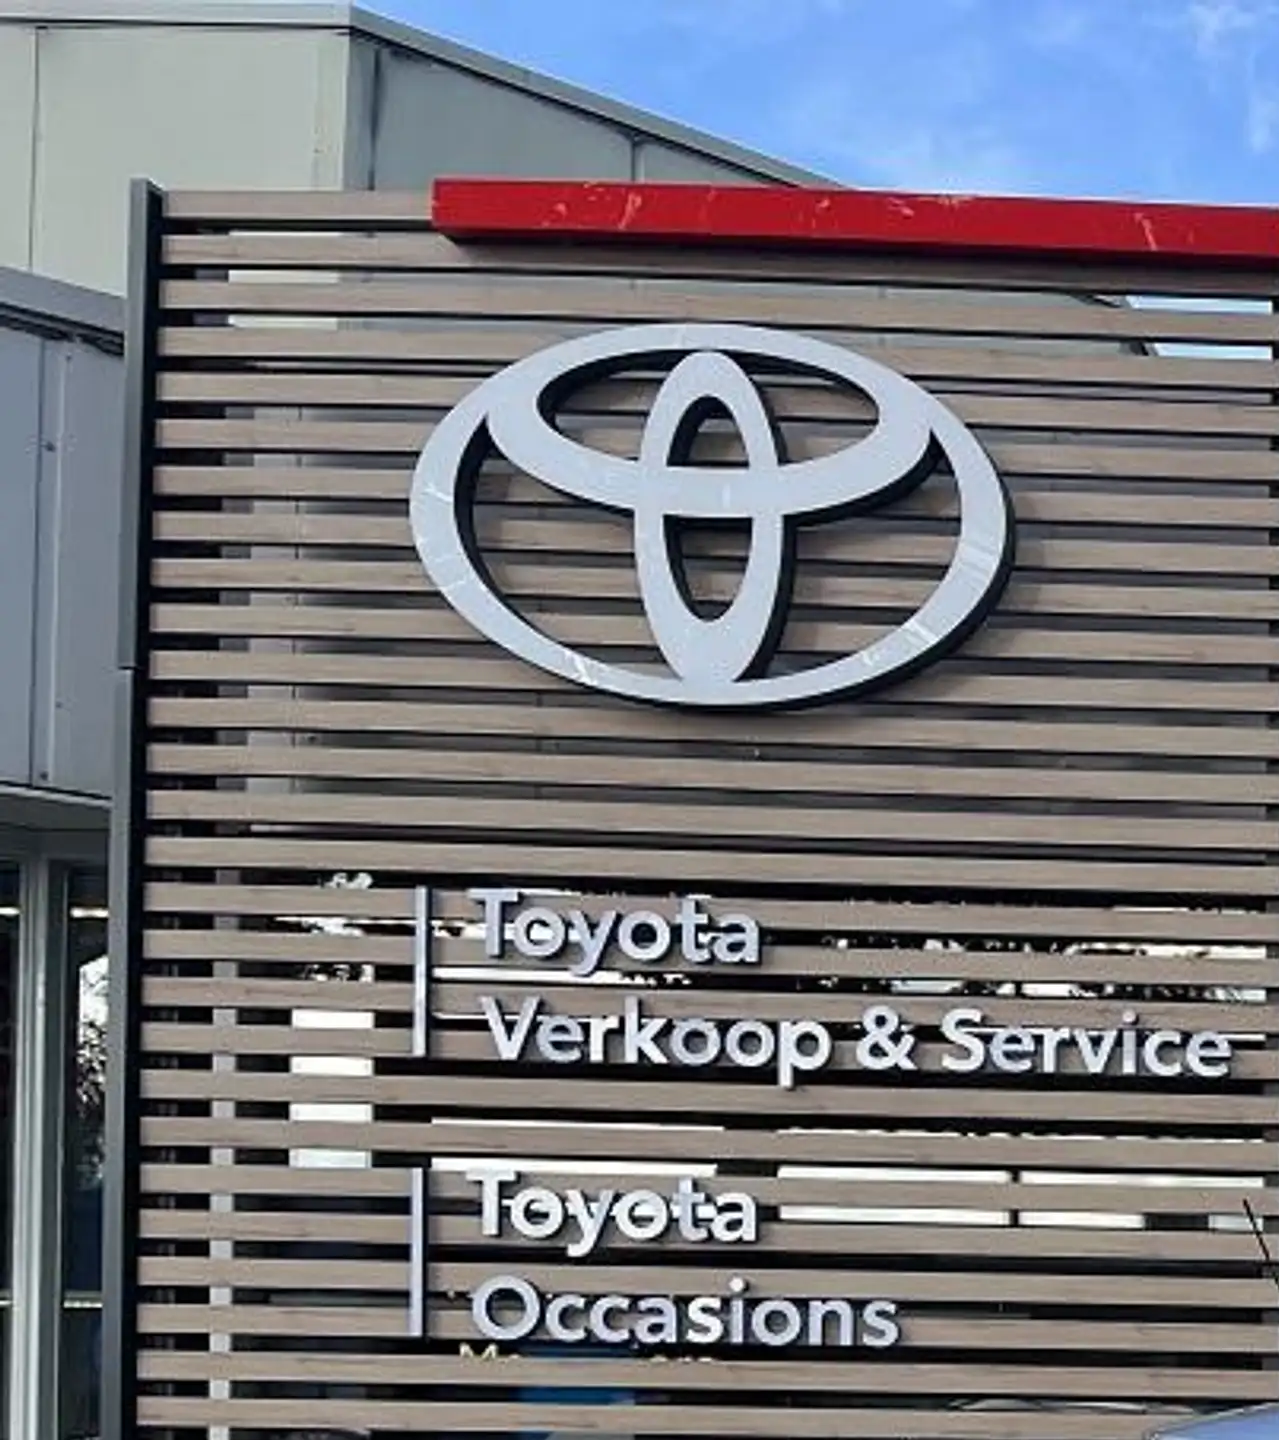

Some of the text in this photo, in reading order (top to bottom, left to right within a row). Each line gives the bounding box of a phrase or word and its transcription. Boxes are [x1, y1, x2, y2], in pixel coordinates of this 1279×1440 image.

[470, 889, 760, 975] Toyota
[481, 997, 1232, 1088] Verkoop & Service
[468, 1170, 760, 1254] Toyota
[470, 1276, 901, 1348] Occasions
